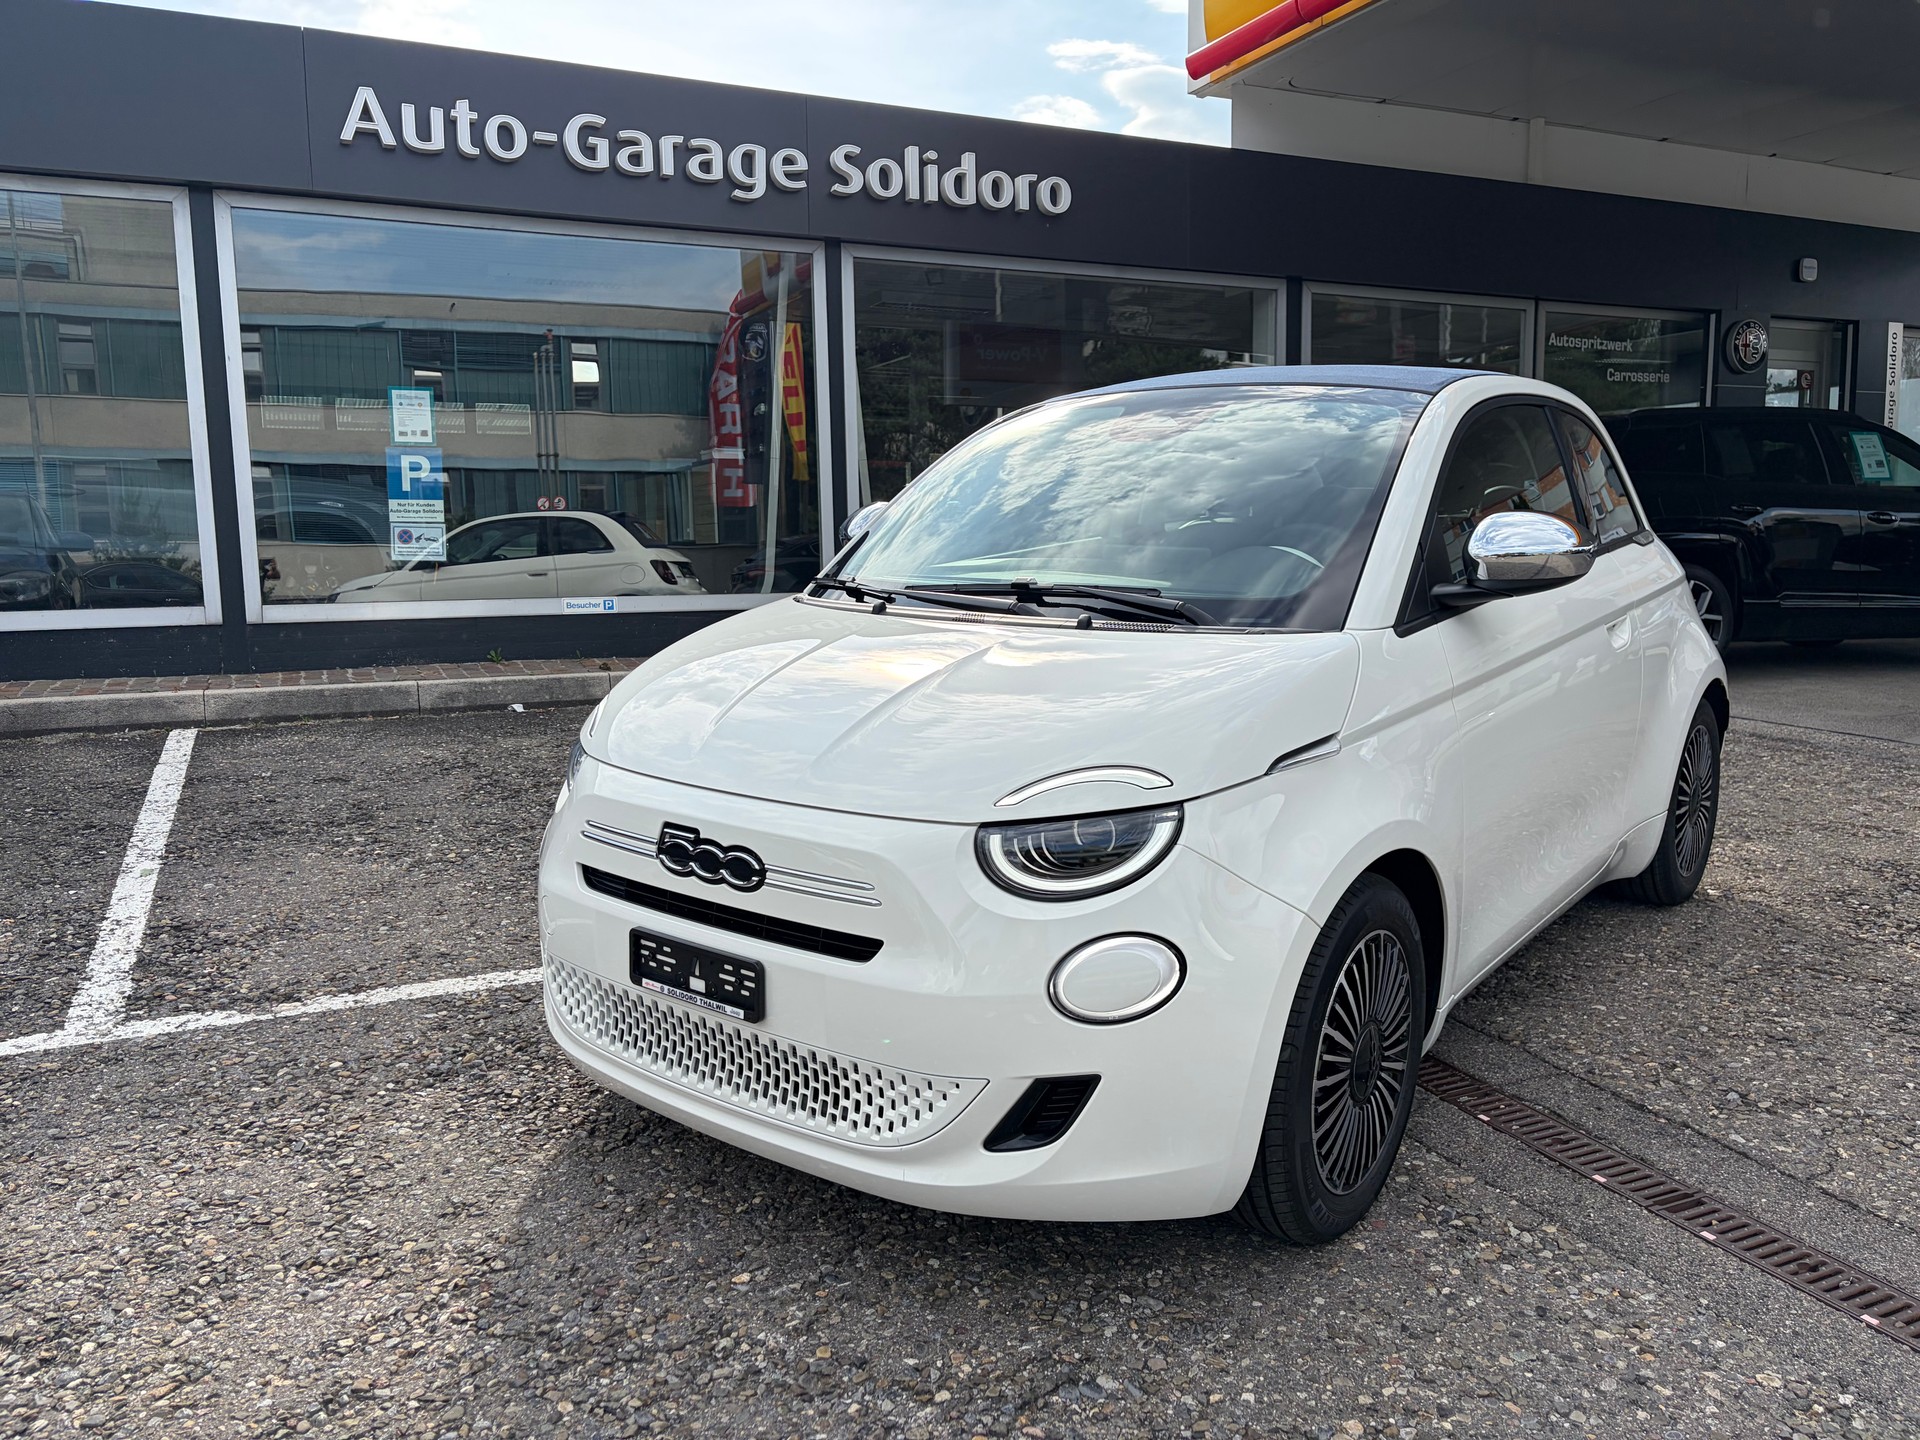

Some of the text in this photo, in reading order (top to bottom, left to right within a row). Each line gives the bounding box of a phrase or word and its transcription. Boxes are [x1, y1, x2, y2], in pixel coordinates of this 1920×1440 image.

[340, 86, 1072, 217] Auto-Garage Solidoro
[1548, 332, 1633, 352] Autospritzwerk
[1888, 331, 1898, 386] Solidoro
[1606, 368, 1671, 384] Carrosserie
[400, 454, 431, 492] P
[658, 826, 765, 889] 500
[667, 988, 698, 1003] SOLIDORO
[699, 998, 728, 1013] THALWIL
